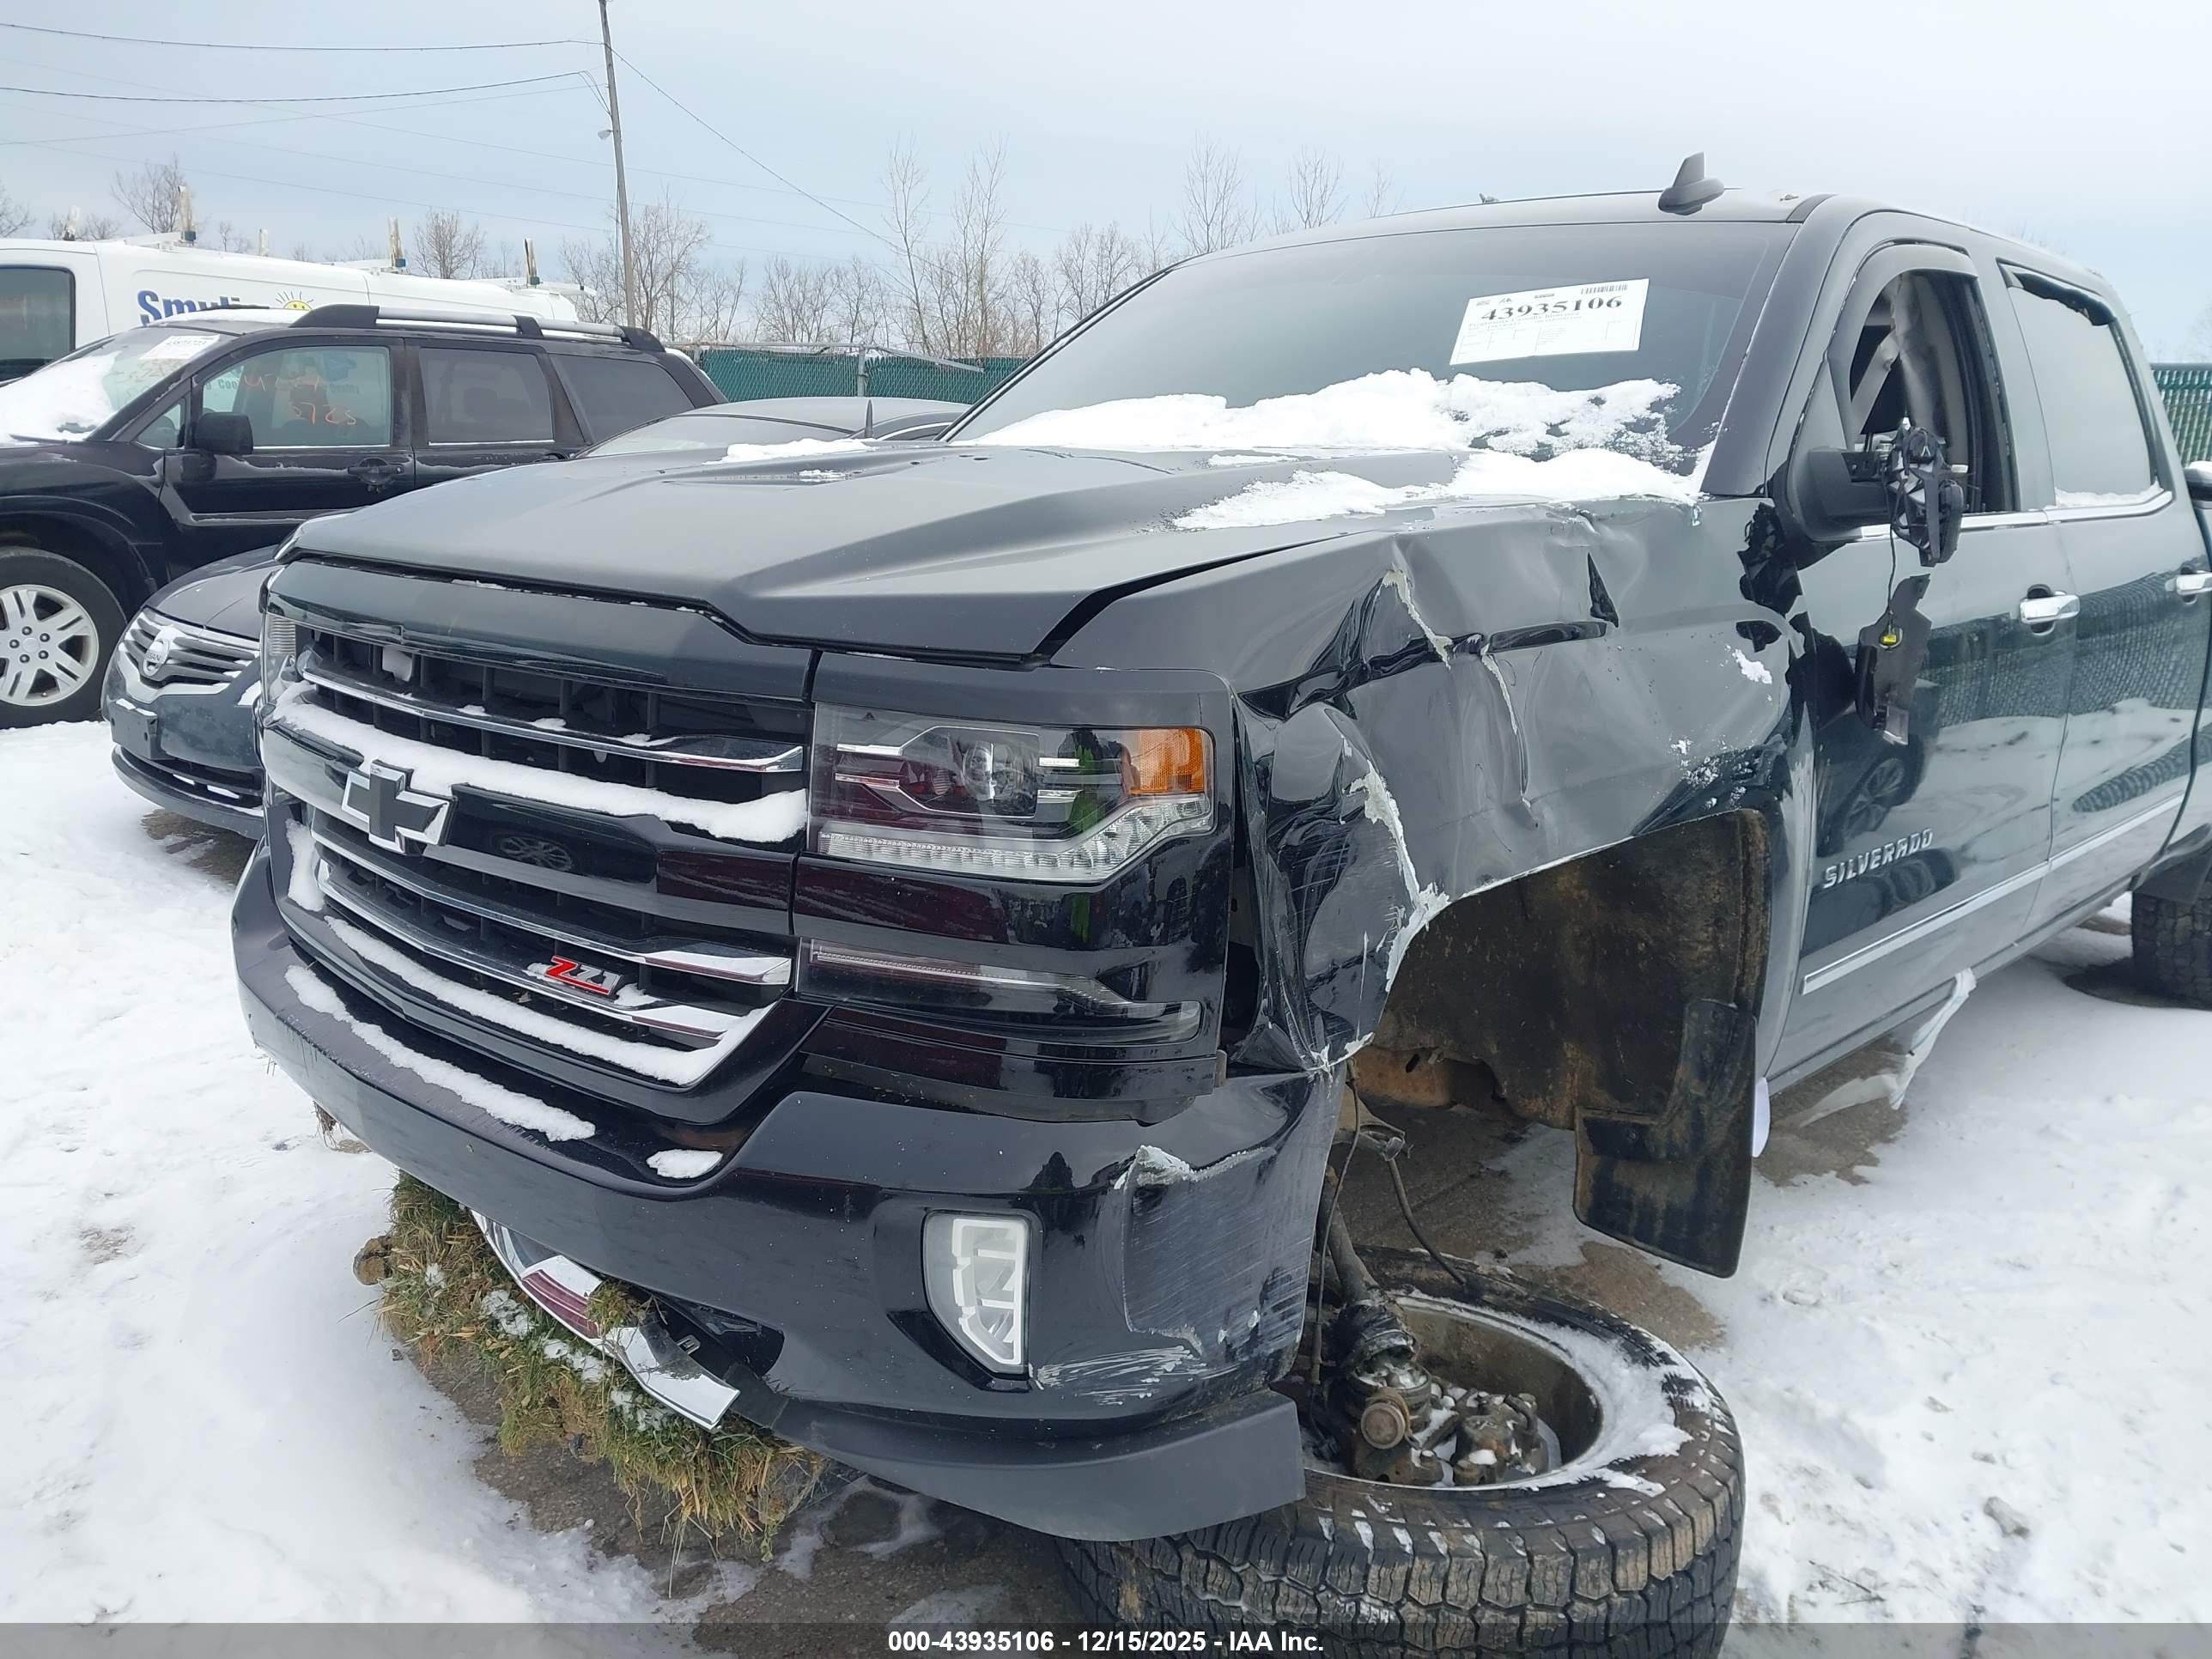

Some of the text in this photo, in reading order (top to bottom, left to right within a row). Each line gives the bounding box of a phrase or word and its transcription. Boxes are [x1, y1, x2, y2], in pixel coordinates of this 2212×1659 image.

[1481, 296, 1622, 320] 43935106
[1822, 829, 1933, 889] SILVERADO
[545, 955, 620, 995] Z71
